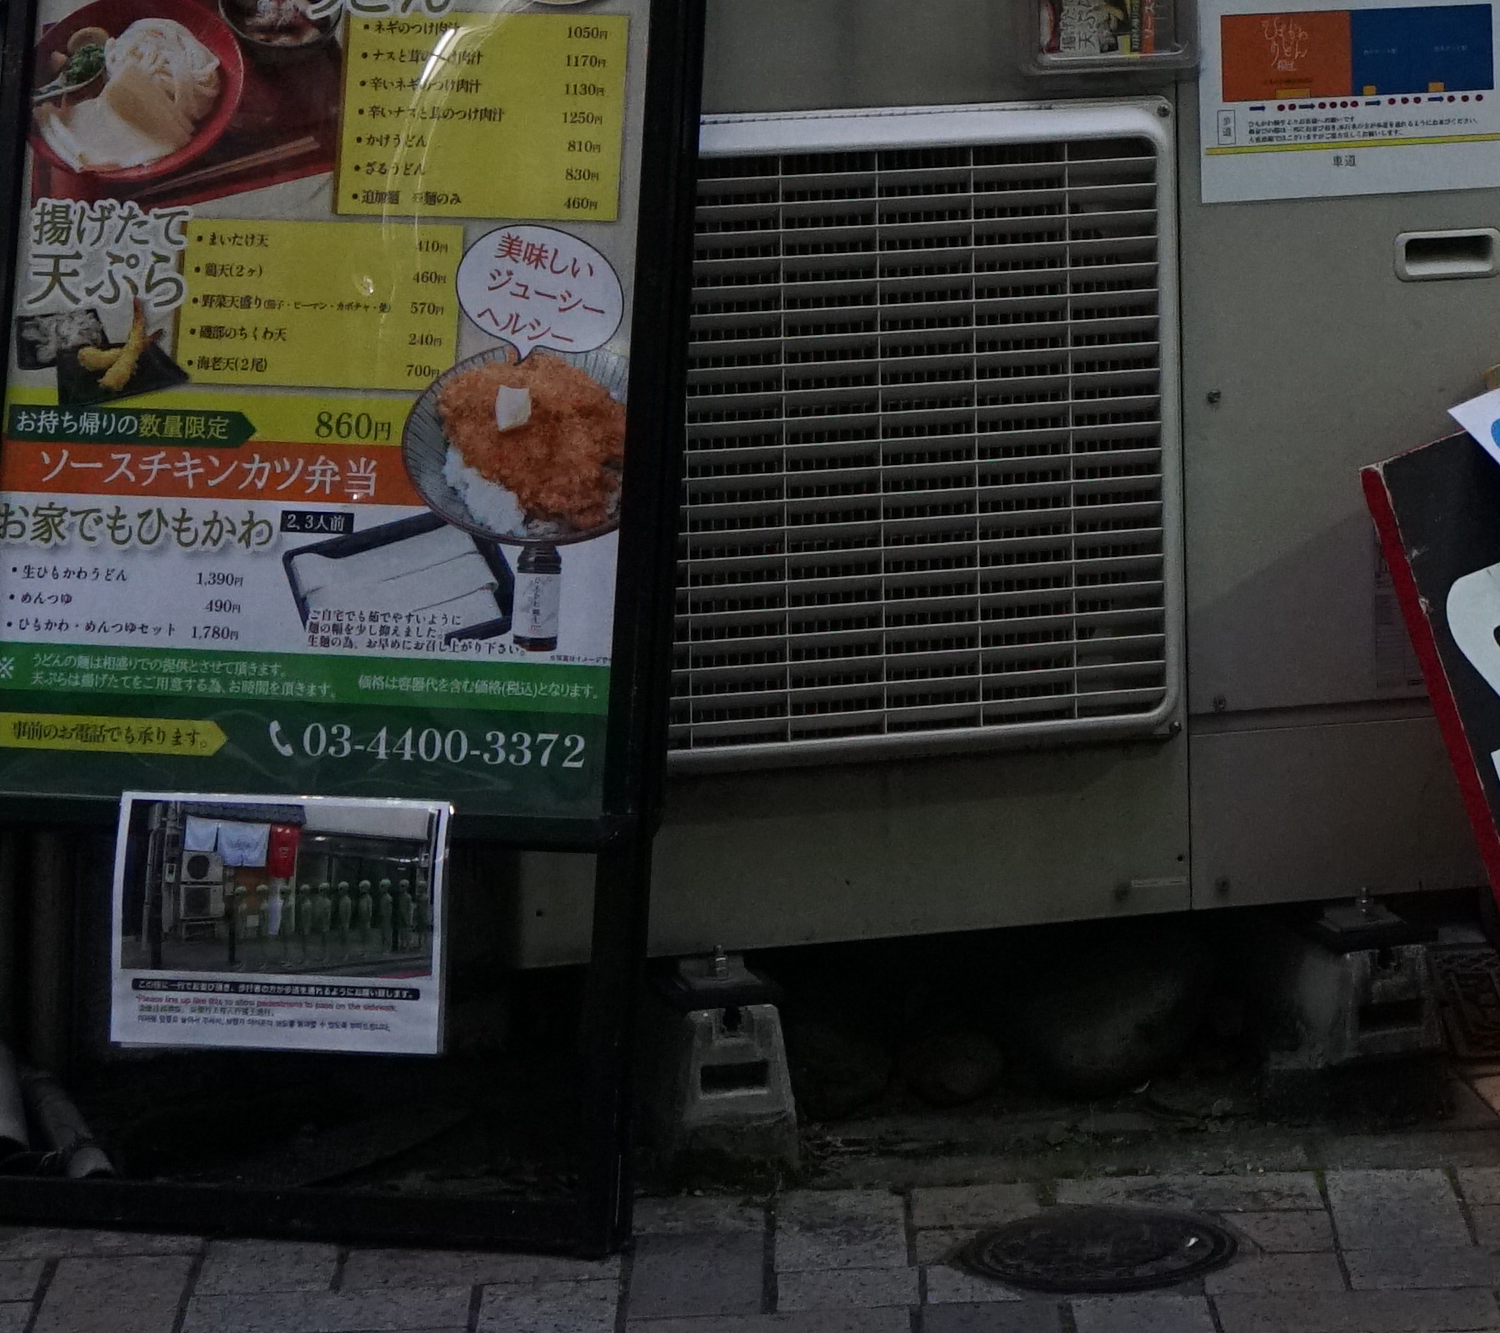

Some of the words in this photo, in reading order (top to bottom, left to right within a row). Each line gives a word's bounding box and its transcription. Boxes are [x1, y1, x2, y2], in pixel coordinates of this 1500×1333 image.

[566, 26, 609, 41] 1050円
[372, 48, 484, 66] ナスと茸のけ肉汁
[564, 54, 607, 70] 1170円
[563, 83, 606, 98] 1130円
[561, 111, 603, 126] 1250円
[365, 134, 427, 148] かけうどん
[567, 140, 602, 155] 810円
[365, 162, 427, 176] ざるうどん
[565, 168, 600, 183] 830円
[563, 197, 599, 212] 460円
[31, 201, 190, 249] 揚げたて
[208, 232, 271, 249] まいたけ天
[493, 231, 595, 279] 美味しい
[26, 250, 186, 310] 天ぷら
[411, 269, 448, 286] 460円
[486, 267, 606, 315] ジューシー
[409, 300, 445, 317] 570円
[476, 306, 575, 343] ヘルシー
[407, 331, 443, 348] 240円
[196, 354, 269, 375] 海老天(2尾)
[405, 363, 440, 380] 700円
[15, 407, 232, 441] お持ち帰りの数量限定
[314, 410, 392, 442] 860円
[39, 448, 380, 498] ソースチキンカツ弁当
[21, 563, 128, 583] 生ひもかわうどん
[196, 571, 245, 589] 1,390円
[20, 592, 74, 606] めんつゆ
[205, 598, 242, 615] 490円
[17, 617, 177, 637] ひもかわ・めんつゆセット
[190, 625, 240, 643] 1,780円
[12, 720, 208, 748] 事前のお電話でも承ります。
[303, 721, 587, 769] 03-4400-3372
